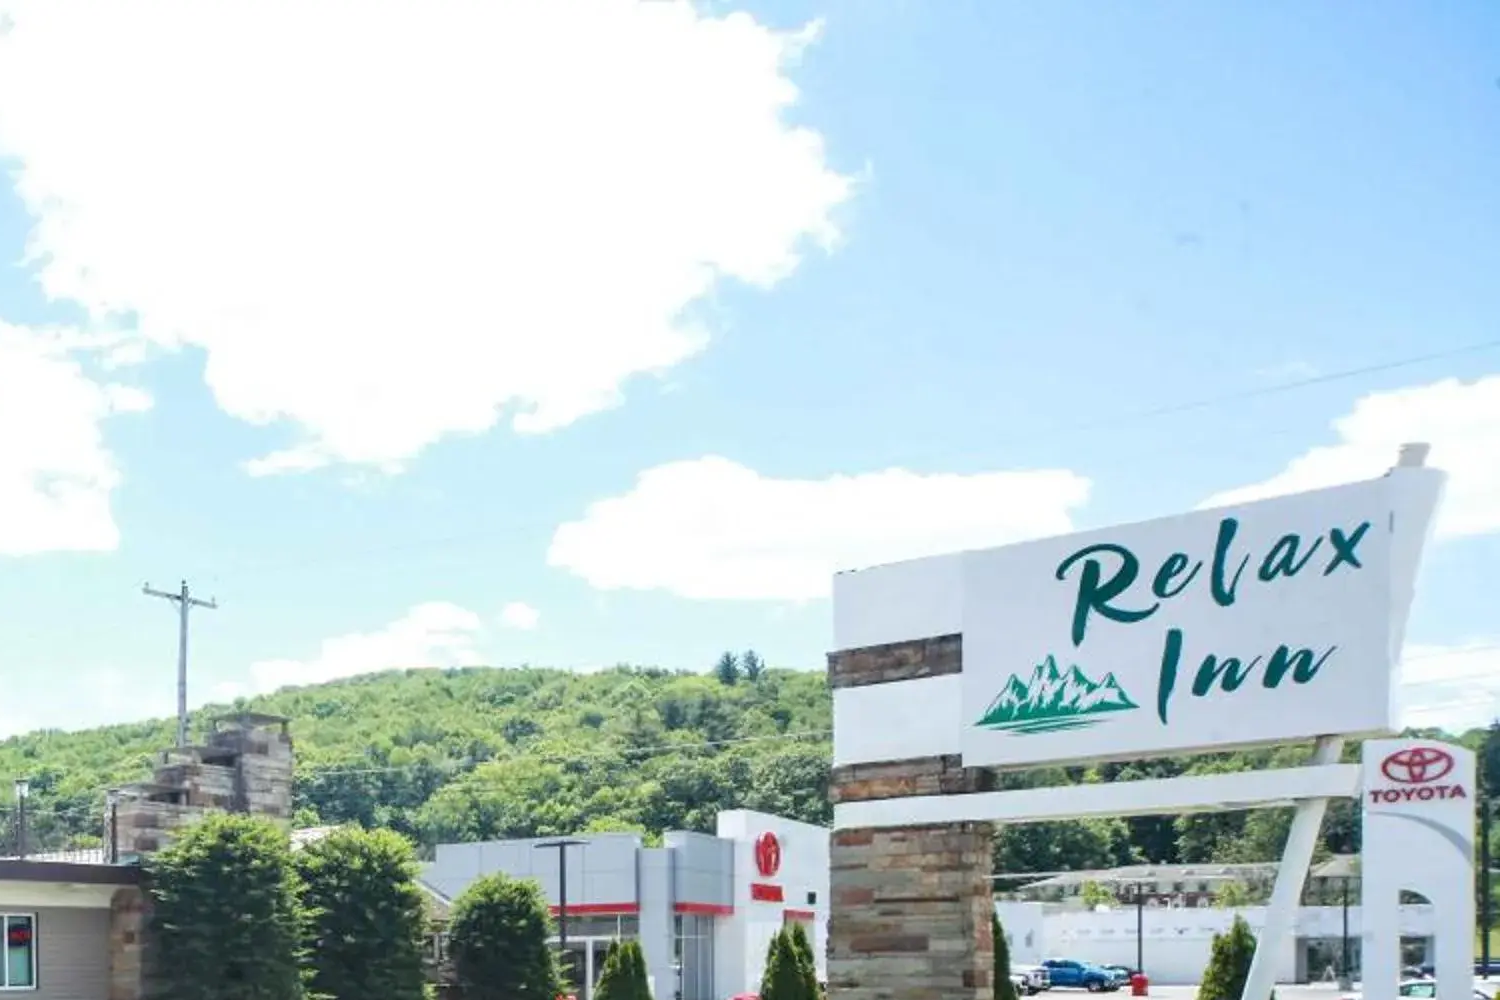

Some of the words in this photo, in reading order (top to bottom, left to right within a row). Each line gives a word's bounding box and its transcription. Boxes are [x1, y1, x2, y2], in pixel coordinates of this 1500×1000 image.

[1055, 517, 1373, 647] Relax
[1156, 627, 1338, 726] Inn
[1369, 784, 1467, 803] TOYOTA
